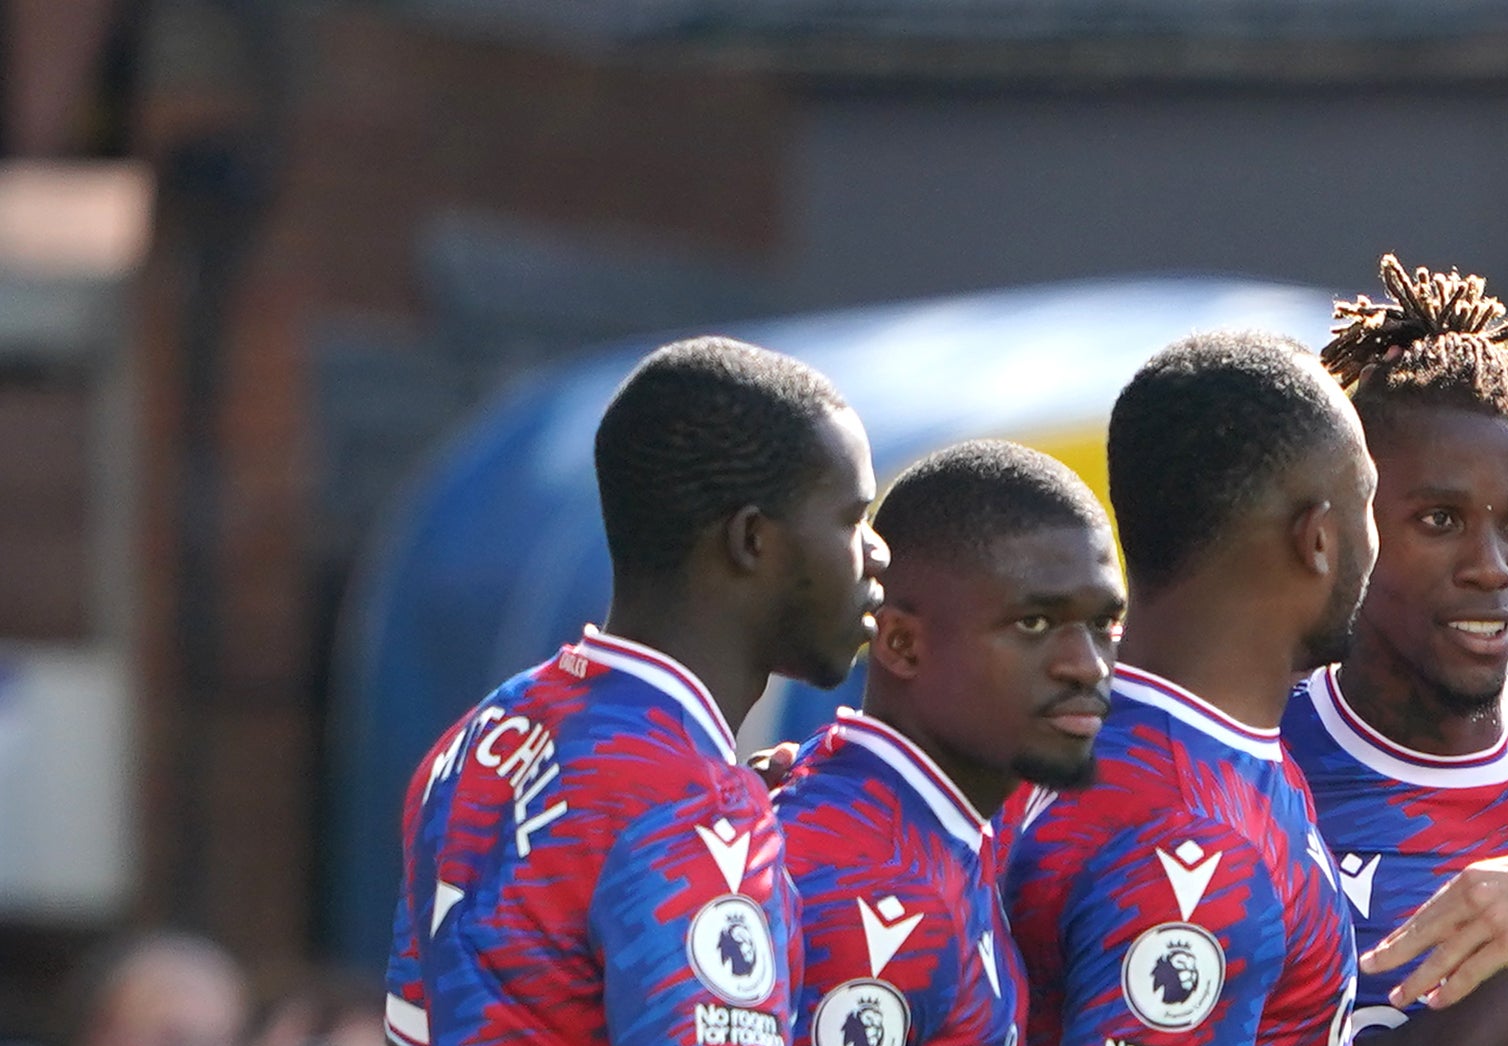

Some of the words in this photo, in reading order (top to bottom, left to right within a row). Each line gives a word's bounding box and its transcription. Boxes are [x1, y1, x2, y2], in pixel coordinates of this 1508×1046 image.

[422, 706, 568, 858] MITCHELL
[695, 1003, 730, 1028] No
[730, 1008, 777, 1037] room
